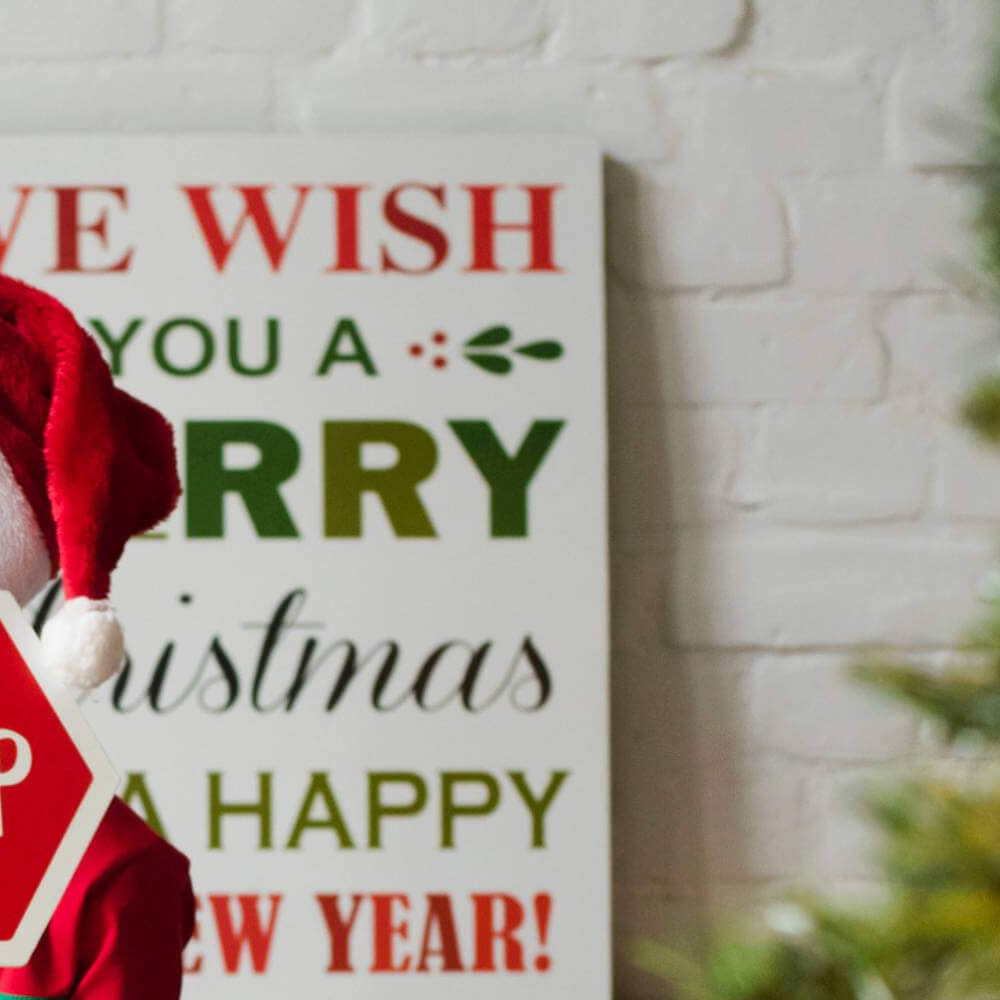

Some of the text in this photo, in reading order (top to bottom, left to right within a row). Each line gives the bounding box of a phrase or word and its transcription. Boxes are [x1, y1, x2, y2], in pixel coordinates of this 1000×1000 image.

[179, 182, 564, 275] WISH
[89, 317, 379, 378] YOU A
[131, 418, 568, 542] RRY
[206, 769, 571, 851] HAPPY
[314, 891, 554, 975] YEAR!
